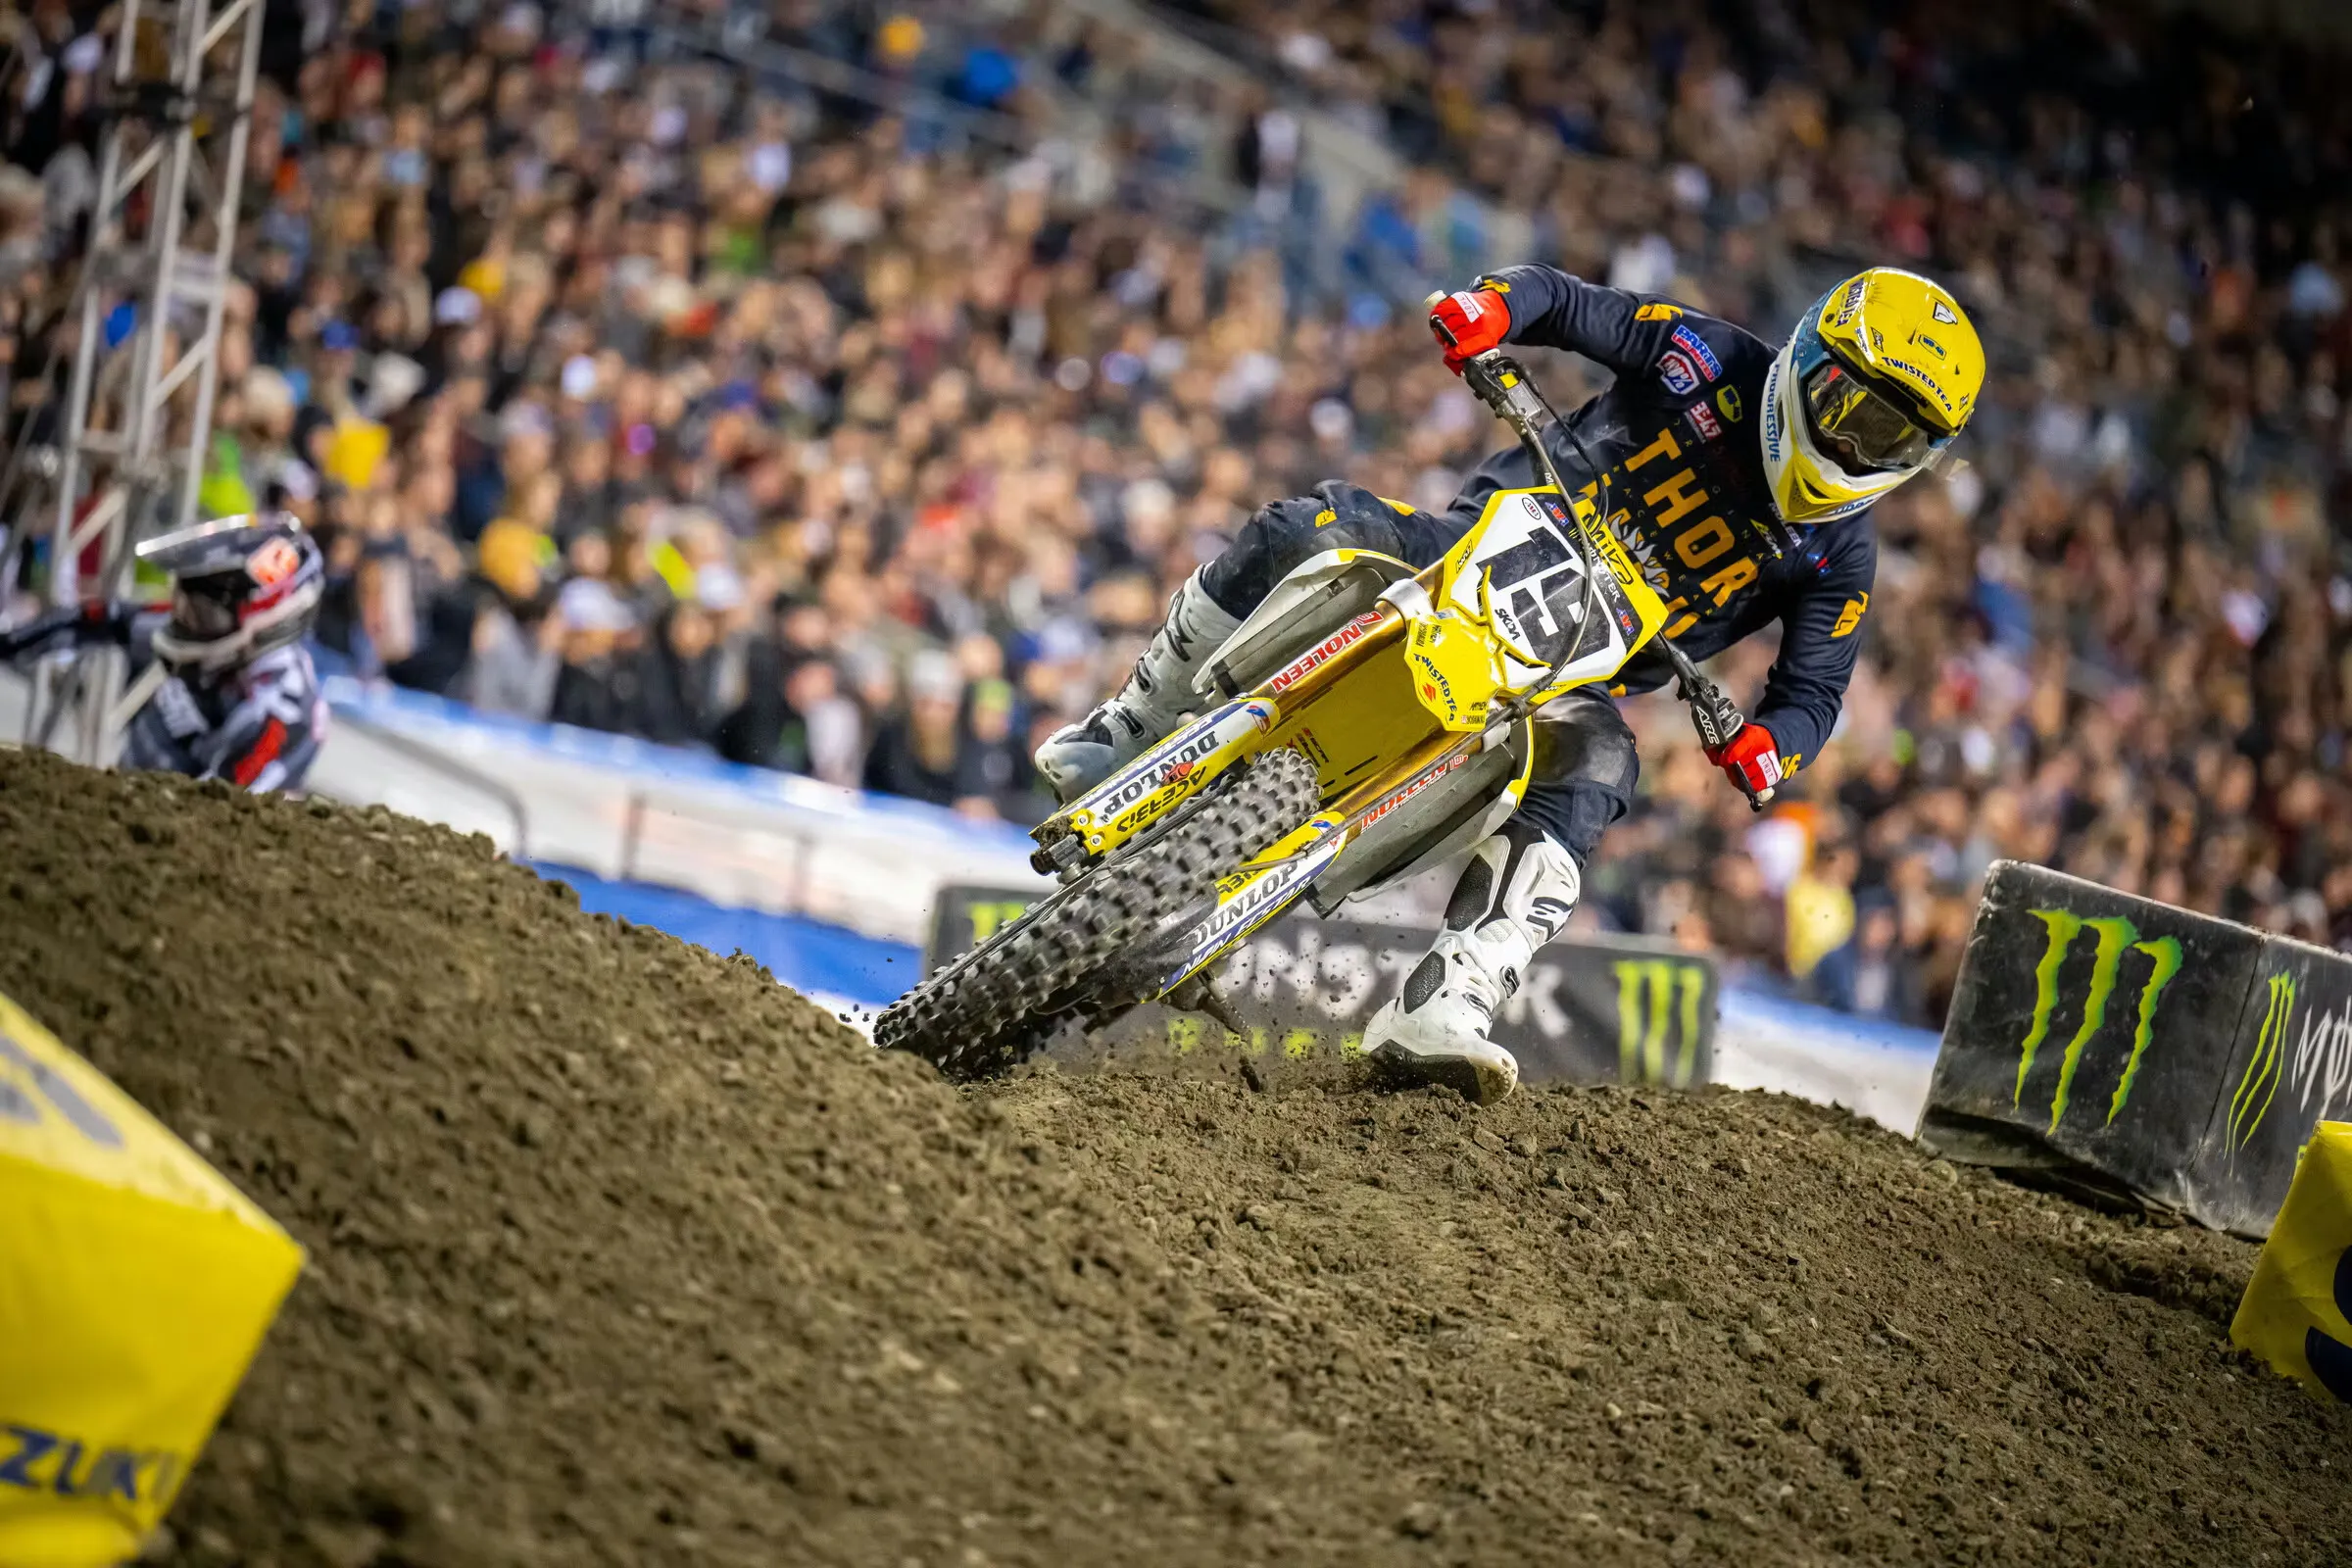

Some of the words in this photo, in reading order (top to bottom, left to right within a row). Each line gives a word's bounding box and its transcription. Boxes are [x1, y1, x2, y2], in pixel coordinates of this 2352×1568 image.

[1665, 358, 1691, 389] 100%
[1675, 325, 1723, 376] PARTS
[1923, 335, 1945, 356] WD-40
[1765, 363, 1783, 464] PROGRESSIVE
[1882, 356, 1936, 390] TWISTED
[1935, 388, 1953, 413] TEA
[1624, 427, 1759, 609] THOR
[1615, 606, 1636, 637] AMA
[1271, 622, 1365, 695] NOLEEN
[1413, 653, 1451, 698] TWISTED
[1446, 695, 1458, 722] TEA
[1695, 705, 1720, 745] ARC
[1103, 729, 1221, 816] DUNLOP
[1193, 860, 1299, 946] DUNLOP
[1235, 875, 1311, 938] ECSTAR
